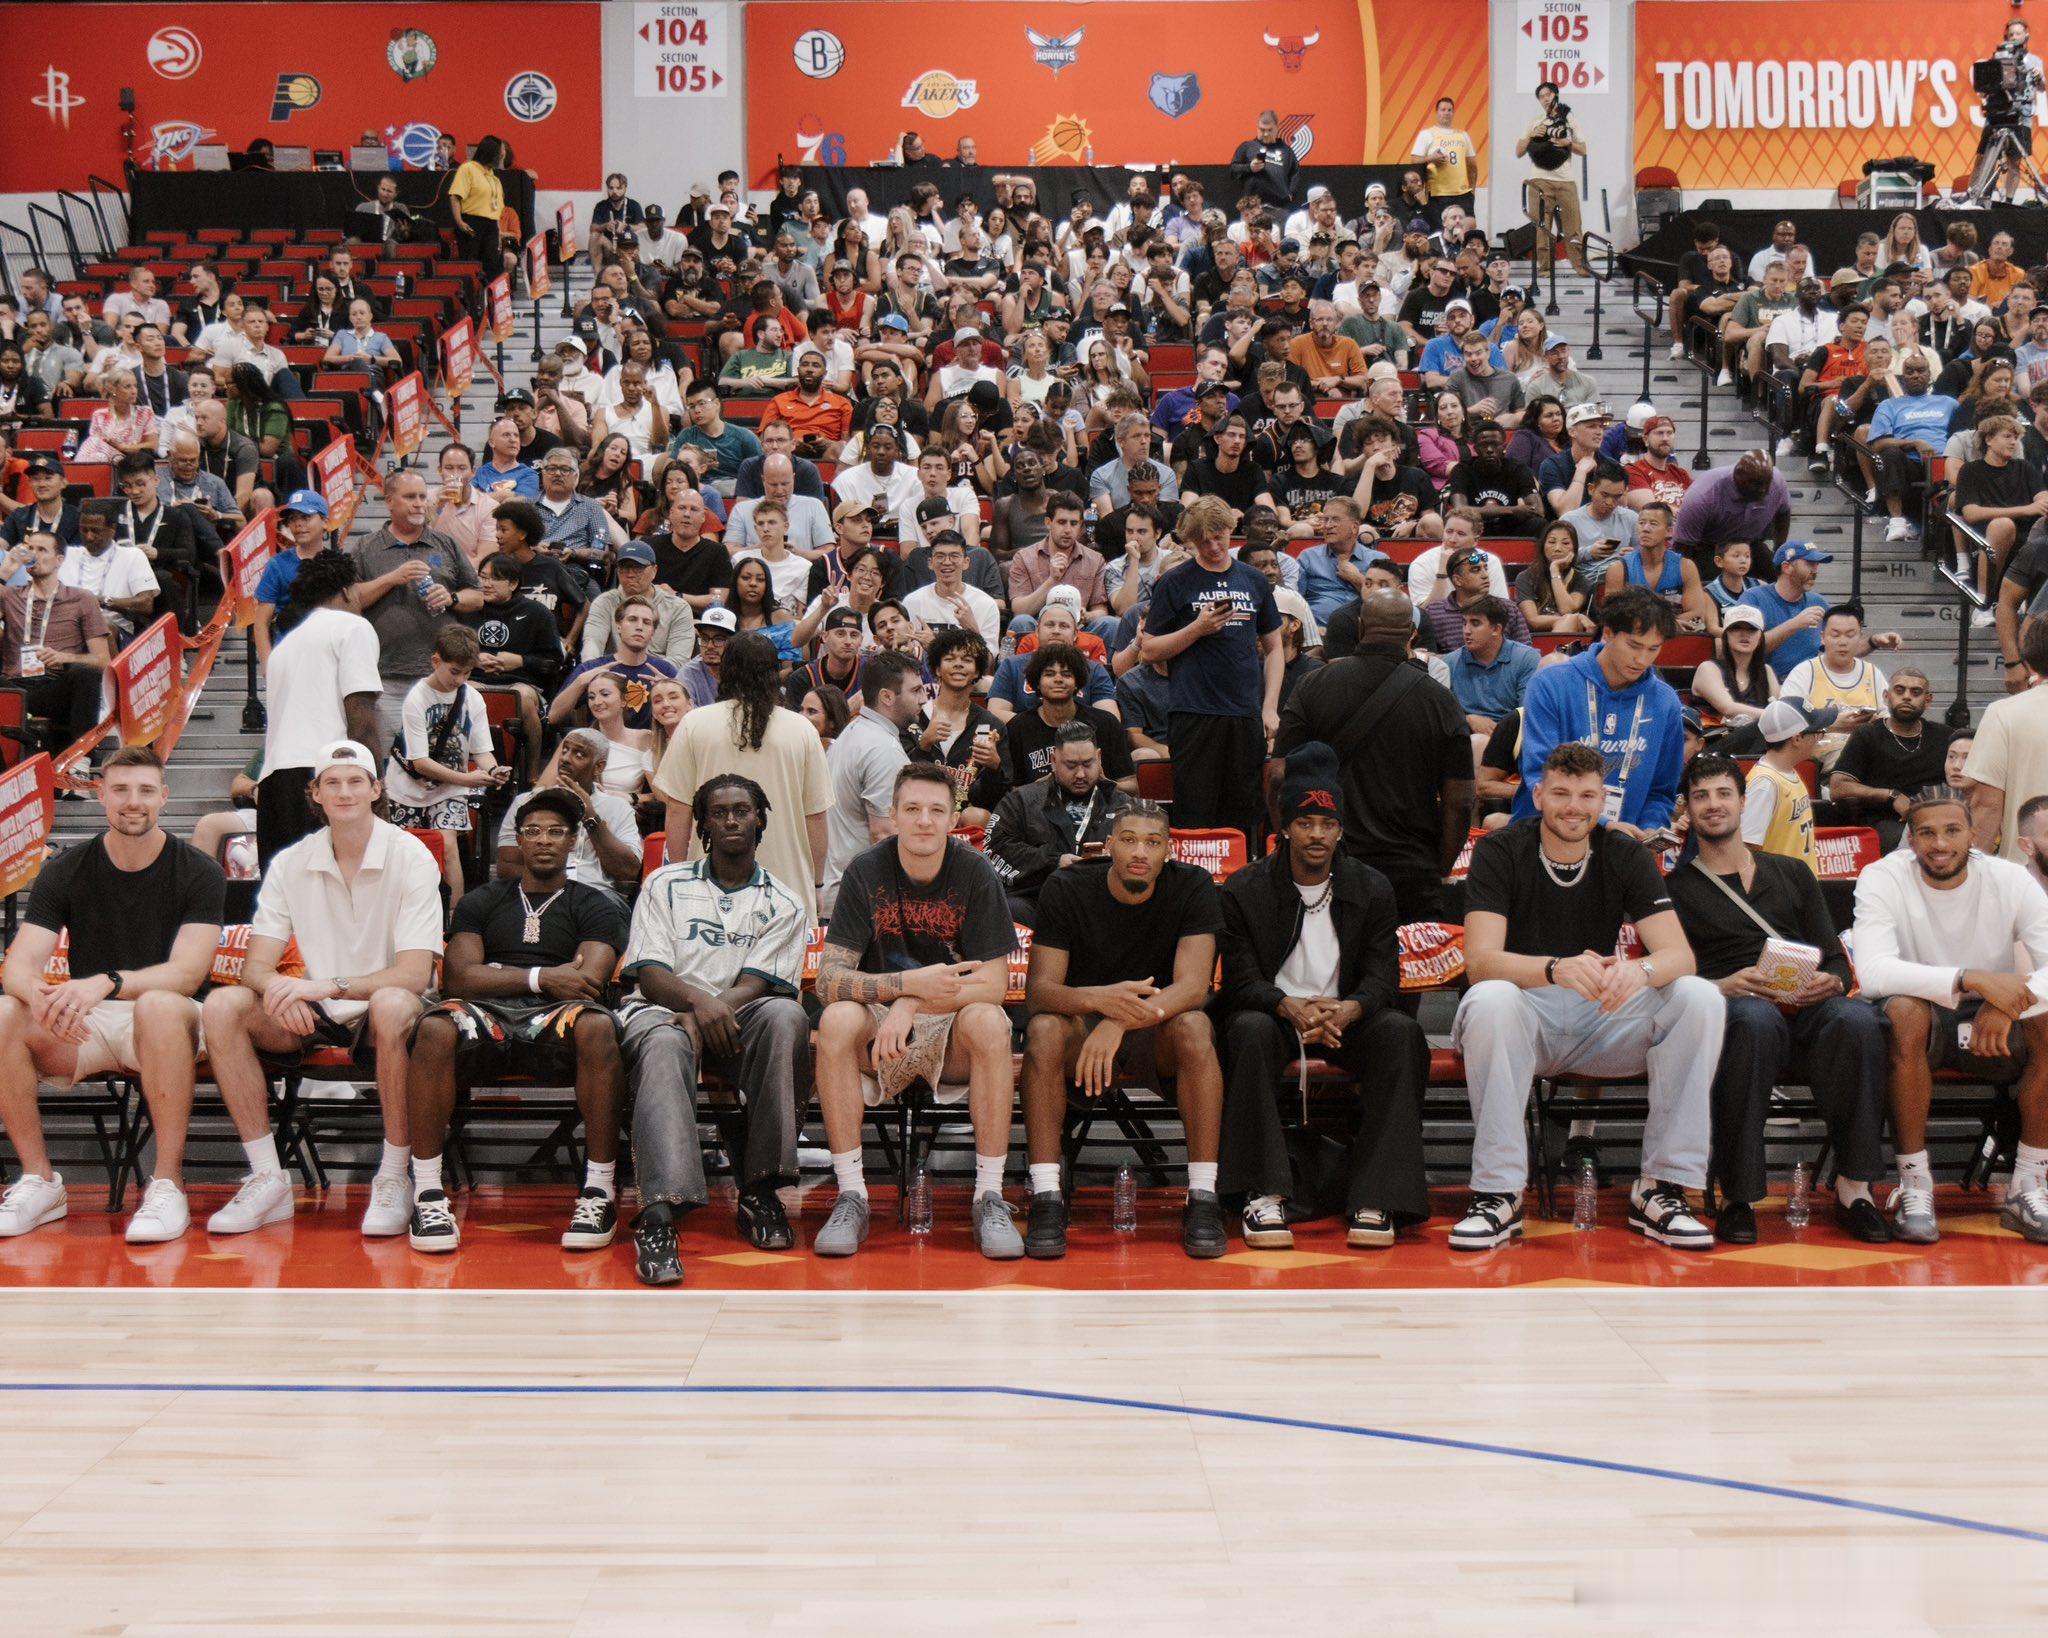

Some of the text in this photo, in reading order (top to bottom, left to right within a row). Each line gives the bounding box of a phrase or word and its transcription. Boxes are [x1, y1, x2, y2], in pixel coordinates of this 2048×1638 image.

[661, 7, 698, 16] SECTION
[1544, 3, 1581, 13] SECTION
[655, 19, 708, 46] 104
[1538, 15, 1589, 42] 105
[661, 53, 698, 63] SECTION
[1035, 50, 1076, 62] HORNETS
[1544, 49, 1581, 59] SECTION
[655, 65, 707, 92] 105
[1538, 61, 1590, 89] 106
[909, 83, 974, 107] LAKERS
[1655, 59, 1958, 131] TOMORROW'S
[796, 132, 847, 166] 76
[1890, 563, 1916, 578] Hh
[1198, 591, 1251, 601] AUBURN
[1181, 839, 1230, 857] SUMMER
[1814, 835, 1861, 855] SUMMER
[1816, 854, 1857, 875] LEAGUE
[1403, 946, 1465, 979] RESERVED
